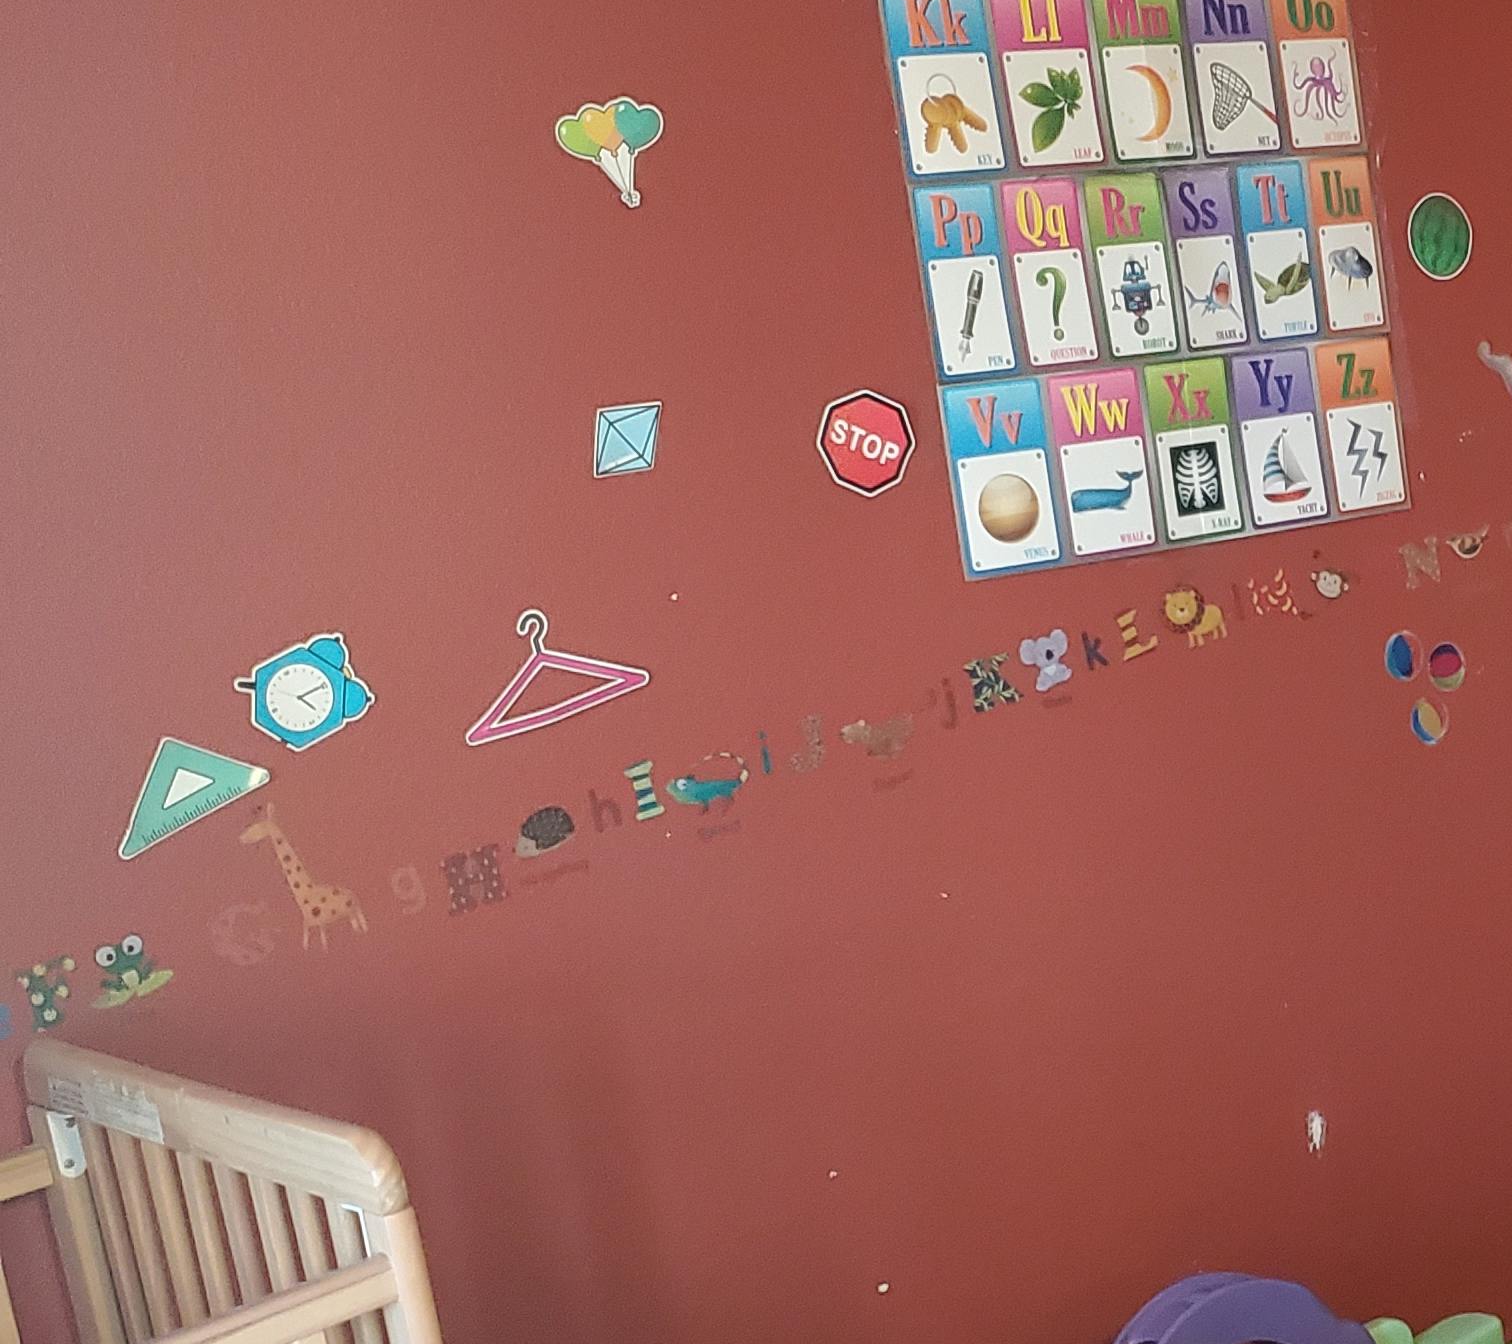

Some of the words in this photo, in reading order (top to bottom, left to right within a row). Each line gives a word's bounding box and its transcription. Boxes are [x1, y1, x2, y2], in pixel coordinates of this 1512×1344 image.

[977, 153, 994, 165] KEY
[1073, 146, 1092, 159] LEAF
[1257, 135, 1271, 146] NET
[1015, 187, 1070, 248] Qq
[1099, 186, 1145, 239] Rr
[1178, 181, 1218, 232] Ss
[1253, 174, 1292, 225] Tt
[1320, 169, 1362, 218] Uu
[928, 193, 983, 256] Pp
[1050, 346, 1088, 359] QUESTION
[1216, 329, 1237, 340] SHARK
[988, 354, 1004, 367] PEN
[1336, 353, 1378, 400] Zz
[1060, 382, 1130, 437] Ww
[1163, 372, 1215, 423] Xx
[1248, 358, 1293, 413] Yy
[830, 419, 900, 465] STOP
[966, 393, 1024, 448] Vv
[1297, 503, 1318, 515] YACHT
[1023, 547, 1050, 558] VENUS
[1119, 532, 1145, 545] WHALE
[1399, 535, 1440, 590] N
[1082, 631, 1108, 670] k
[963, 652, 1024, 712] K
